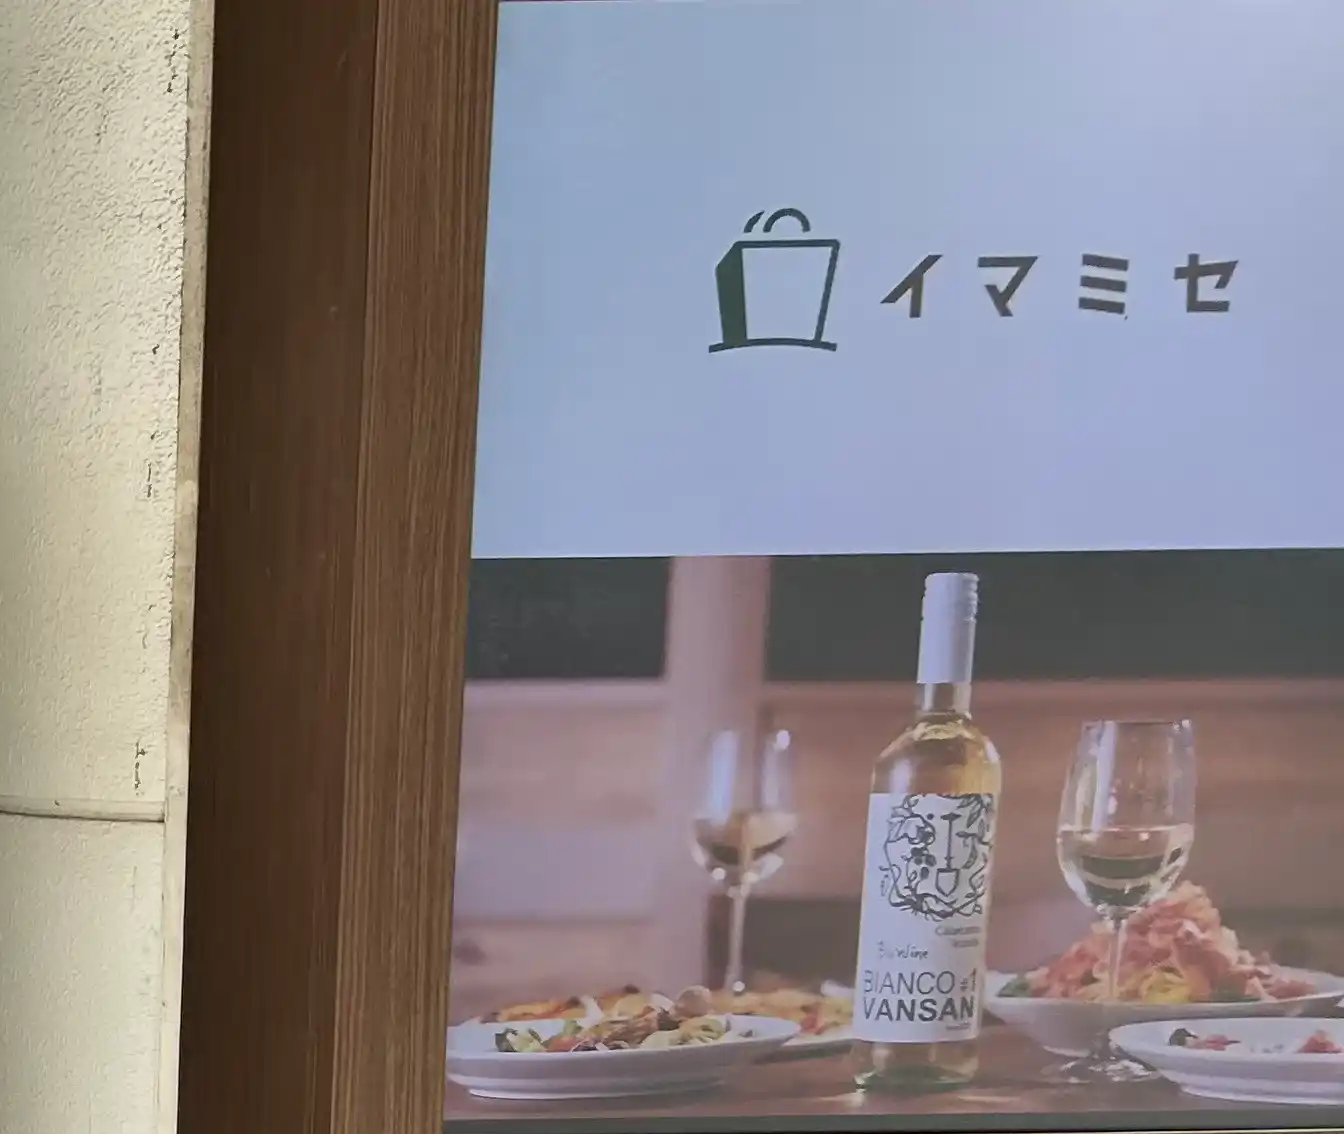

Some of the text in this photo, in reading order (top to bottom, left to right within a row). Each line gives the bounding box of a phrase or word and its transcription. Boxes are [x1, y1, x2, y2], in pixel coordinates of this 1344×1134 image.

[880, 254, 1239, 319] イマミセ
[864, 970, 955, 995] BIANCO
[863, 995, 974, 1022] VANSAN
